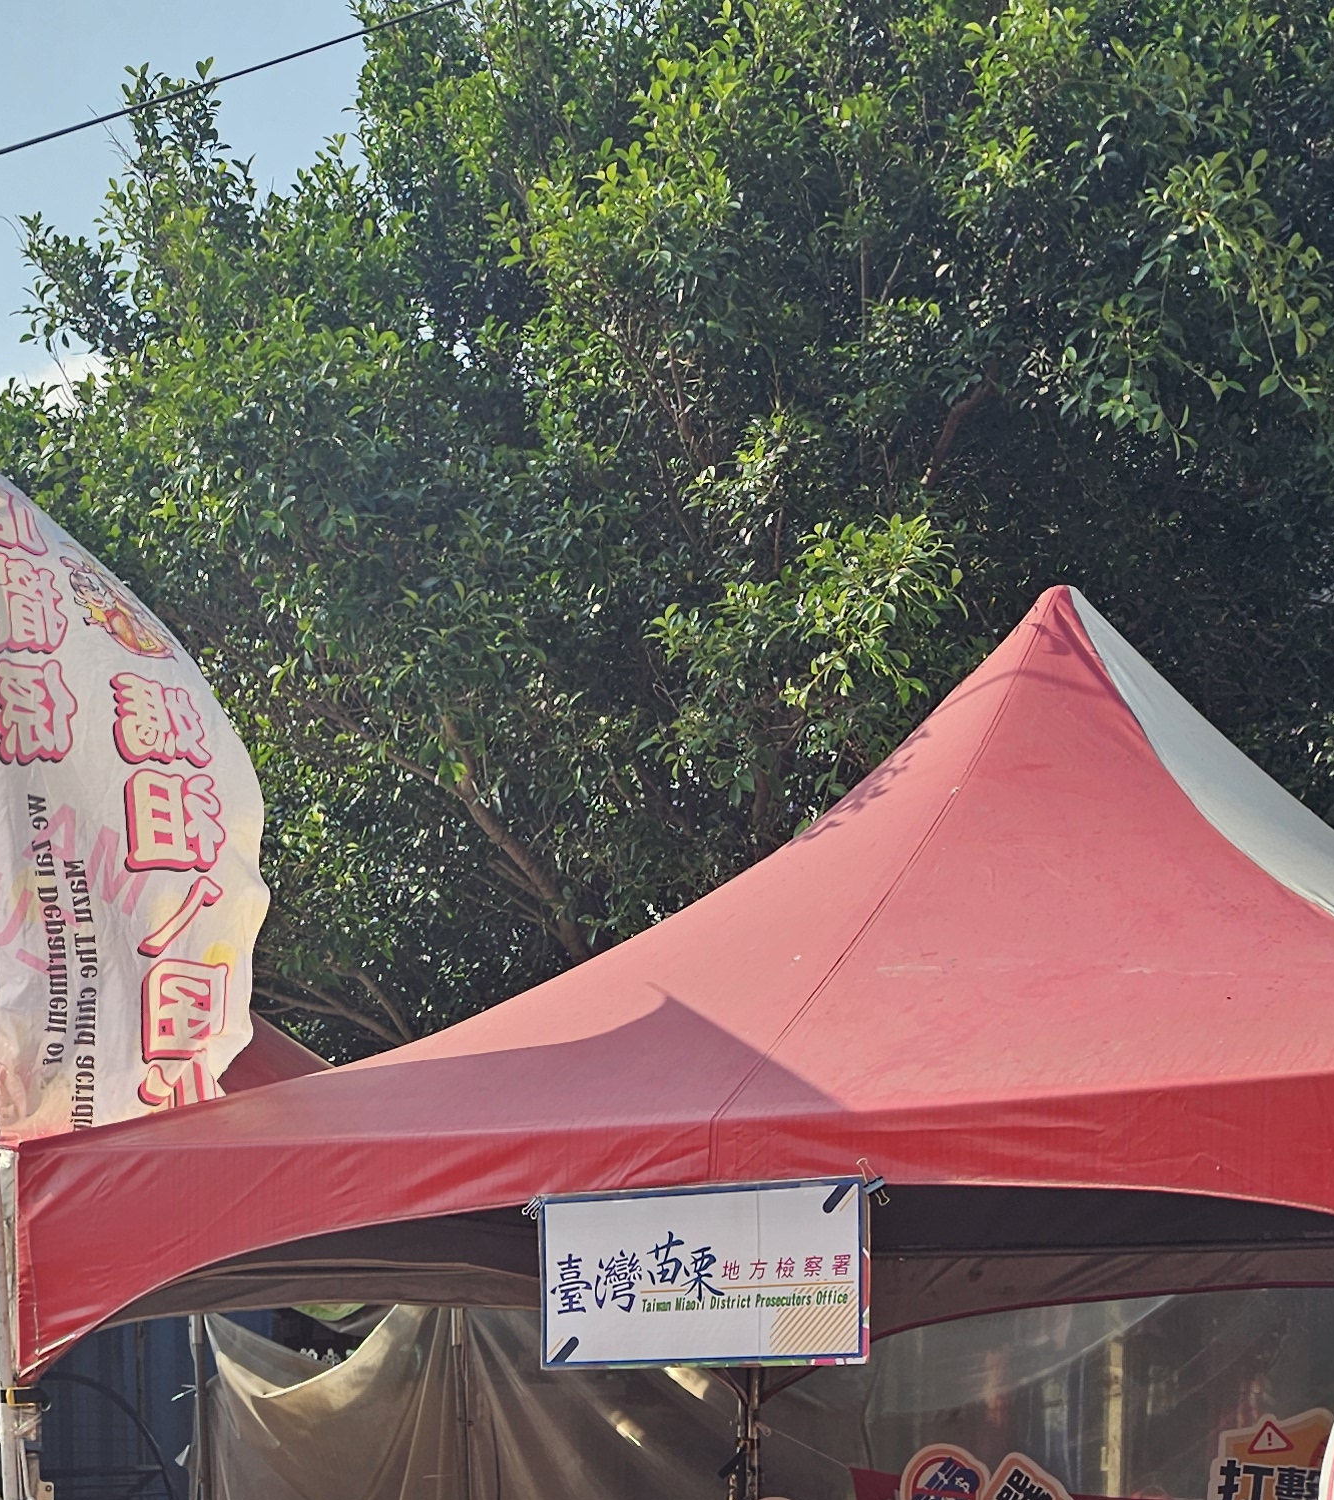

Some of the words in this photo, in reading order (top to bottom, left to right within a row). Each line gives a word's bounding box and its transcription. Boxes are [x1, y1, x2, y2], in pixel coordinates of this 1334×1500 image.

[550, 1231, 852, 1316] 臺灣苗栗地方檢察署
[641, 1298, 672, 1313] Taiwan
[710, 1293, 751, 1310] District
[755, 1291, 812, 1310] Prosecutors
[815, 1291, 849, 1306] Office
